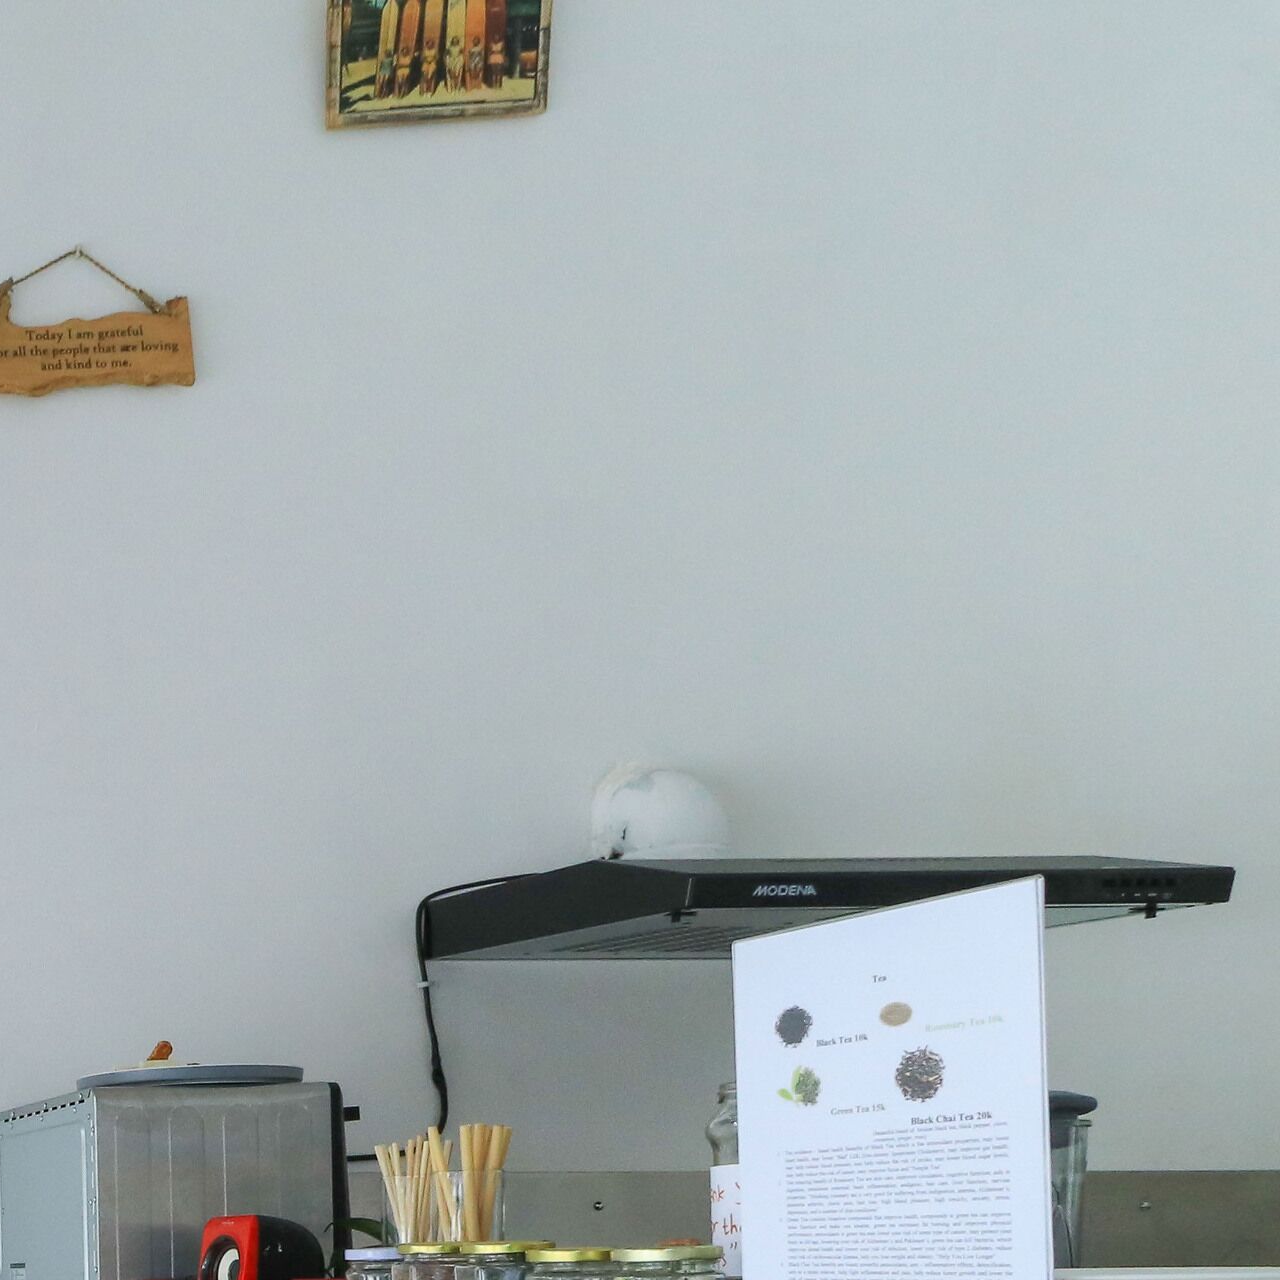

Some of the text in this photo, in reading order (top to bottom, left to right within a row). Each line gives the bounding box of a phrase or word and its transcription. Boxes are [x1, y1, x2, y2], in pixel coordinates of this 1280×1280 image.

[25, 325, 144, 343] Today I am grateful
[12, 346, 26, 357] all
[30, 345, 47, 356] the
[52, 344, 89, 359] people
[93, 343, 116, 353] that
[120, 344, 137, 352] are
[141, 341, 180, 353] loving
[41, 358, 132, 371] and kind to me.
[752, 885, 817, 896] MODENA
[872, 974, 887, 984] Tea
[816, 1038, 837, 1047] Black
[839, 1036, 852, 1044] Tea
[856, 1105, 870, 1113] Tea
[911, 1111, 993, 1126] Black Chai Tea 20k
